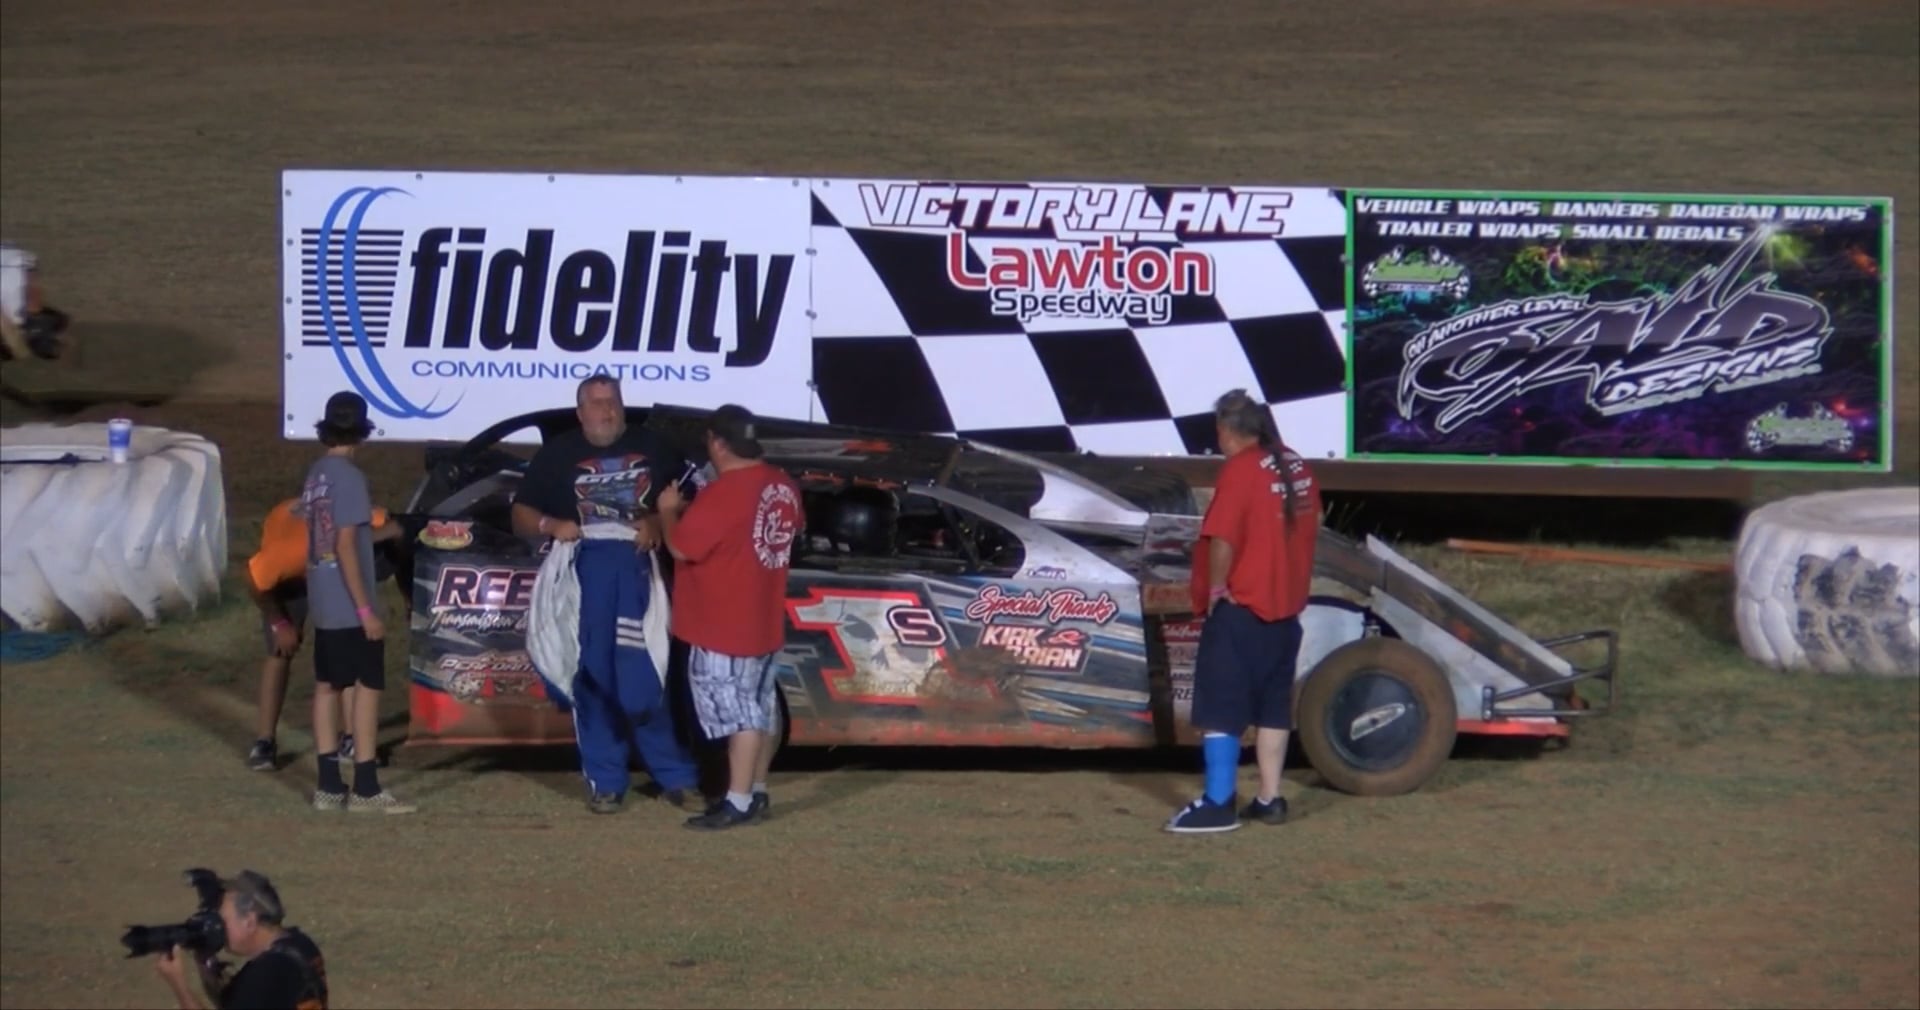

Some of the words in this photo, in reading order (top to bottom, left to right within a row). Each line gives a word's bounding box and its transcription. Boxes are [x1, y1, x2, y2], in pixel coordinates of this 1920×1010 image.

[858, 184, 1118, 238] VICTORY
[1122, 189, 1293, 238] LANE
[1356, 199, 1450, 215] VEHICLE
[1457, 200, 1541, 216] WRAPS
[1552, 202, 1660, 218] BANNERS
[1669, 204, 1777, 220] RACECAR
[1782, 206, 1868, 222] WRAPS
[1377, 220, 1474, 236] TRAILER
[1478, 222, 1562, 238] WRAPS
[1572, 224, 1650, 240] SMALL
[1655, 226, 1744, 242] DECALS
[949, 232, 1212, 293] Lawton
[403, 227, 796, 367] fidelity
[992, 287, 1170, 323] Speedway
[1428, 305, 1520, 347] ANOTHER
[1523, 298, 1585, 315] LEVEL
[411, 360, 711, 382] COMMUNICATIONS
[1602, 337, 1821, 402] DESIGNS
[966, 584, 1050, 625] Special
[1048, 587, 1117, 625] Thanks
[981, 625, 1045, 648] KIRK
